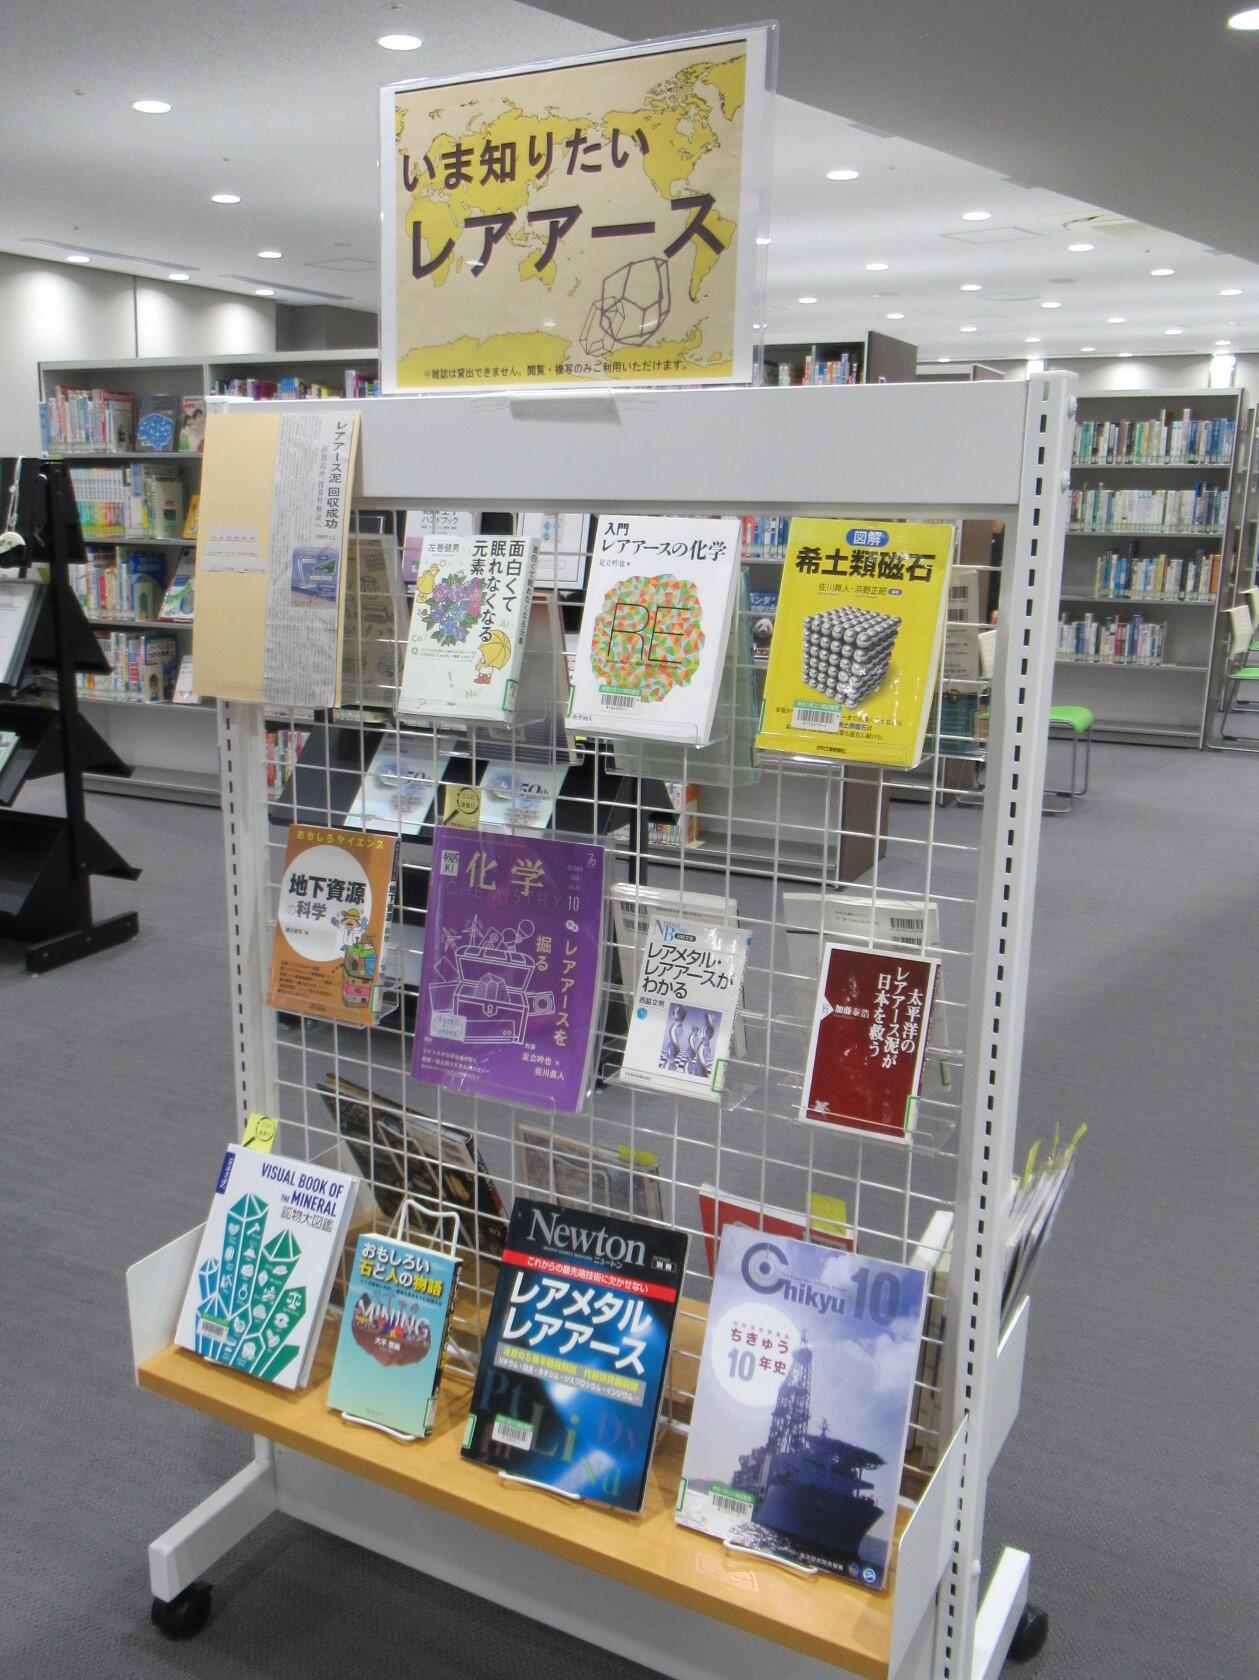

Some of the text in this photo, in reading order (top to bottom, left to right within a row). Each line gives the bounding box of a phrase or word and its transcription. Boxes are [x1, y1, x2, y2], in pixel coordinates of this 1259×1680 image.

[402, 127, 650, 192] いま知りたい
[412, 193, 725, 280] レアアース
[329, 421, 348, 484] レアアース泥
[604, 522, 629, 536] 入門
[853, 531, 882, 546] 図解
[470, 540, 489, 576] 元素
[602, 539, 727, 561] レアアースの化学
[795, 546, 935, 582] 希土類磁石
[479, 540, 505, 642] 眠れなくなる
[502, 540, 526, 612] 面白くて
[607, 602, 691, 664] RE
[296, 830, 384, 850] おもしろサイエンス
[289, 873, 366, 905] 地下資源
[466, 851, 546, 896] 化学
[287, 900, 327, 920] の科学
[568, 895, 580, 911] 10
[535, 935, 552, 972] 掘る
[554, 940, 579, 1046] レアアースを
[642, 976, 688, 999] わかる
[645, 960, 734, 990] レアアースが
[869, 974, 891, 1057] 日本を救う
[882, 967, 910, 1069] レアアース泥が
[901, 989, 923, 1053] 太平洋の
[261, 1163, 344, 1199] VISUAL BOOK OF
[291, 1191, 337, 1217] MINERAL
[526, 1208, 646, 1266] Newton
[362, 1243, 431, 1273] おもしろい
[527, 1256, 649, 1293] これからの最先端技術に欠かせない
[593, 1256, 624, 1270] ニュートン
[360, 1259, 443, 1297] 石と人の物語
[851, 1267, 900, 1326] 10
[509, 1271, 652, 1333] レアメタル
[502, 1306, 647, 1376] レアアース
[730, 1327, 790, 1354] ちきゅう
[728, 1348, 787, 1382] 10年史
